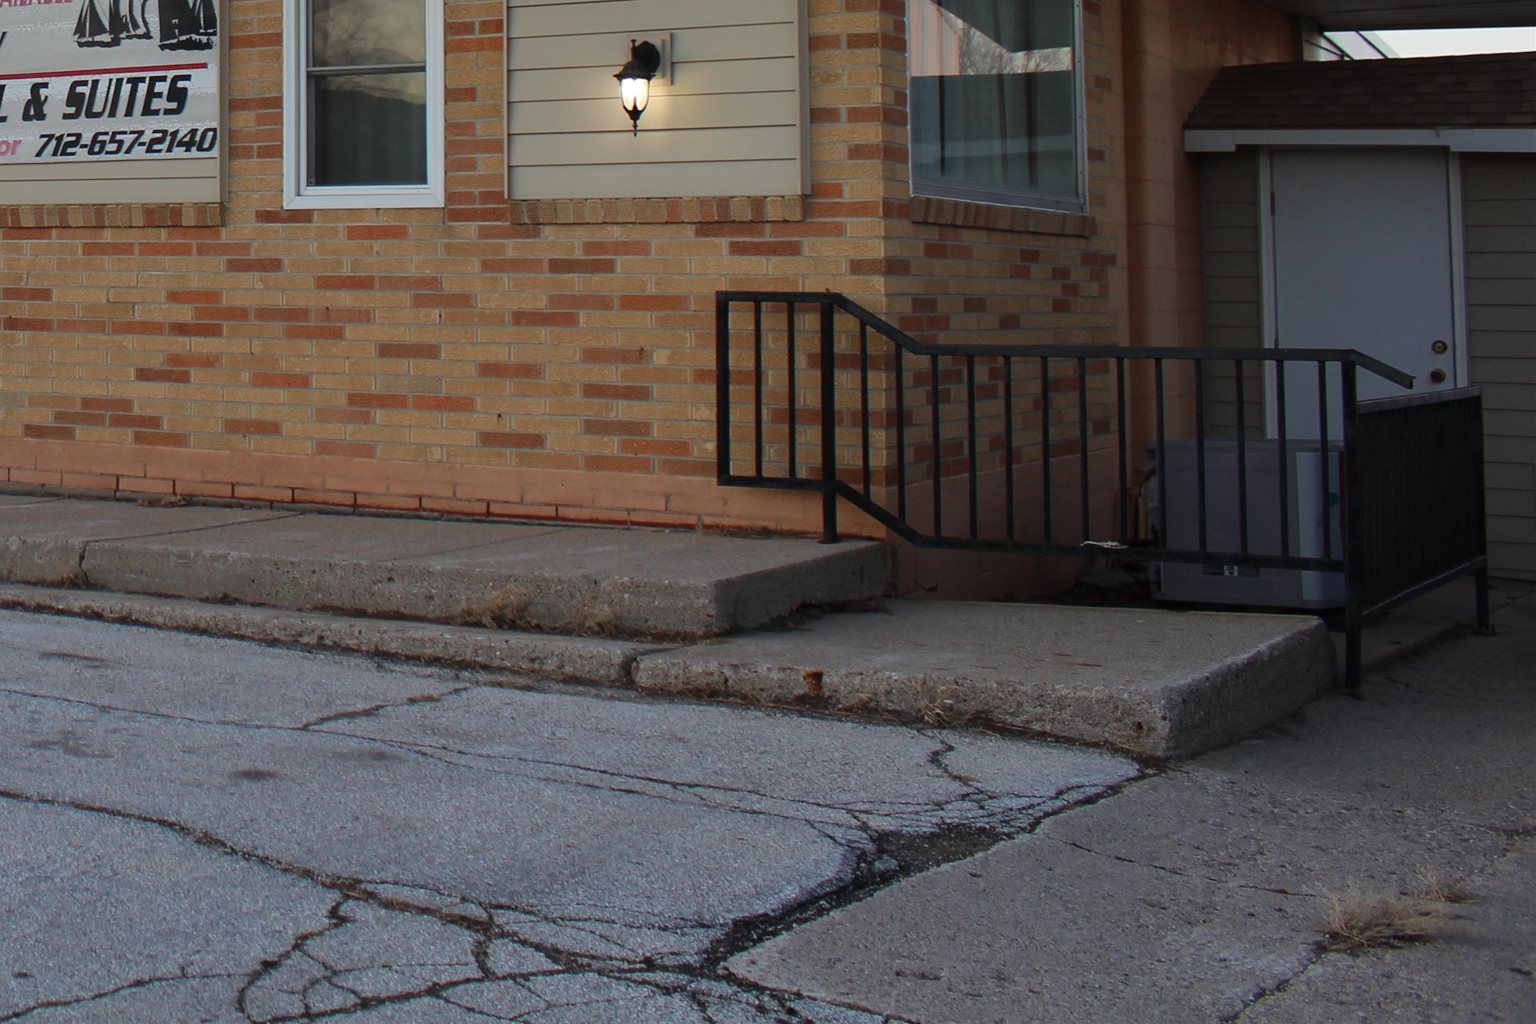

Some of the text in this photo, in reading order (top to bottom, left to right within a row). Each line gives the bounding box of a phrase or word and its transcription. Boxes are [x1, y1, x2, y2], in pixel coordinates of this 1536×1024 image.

[22, 82, 49, 121] &
[62, 74, 192, 120] SUITES
[35, 127, 218, 157] 712-657-2140
